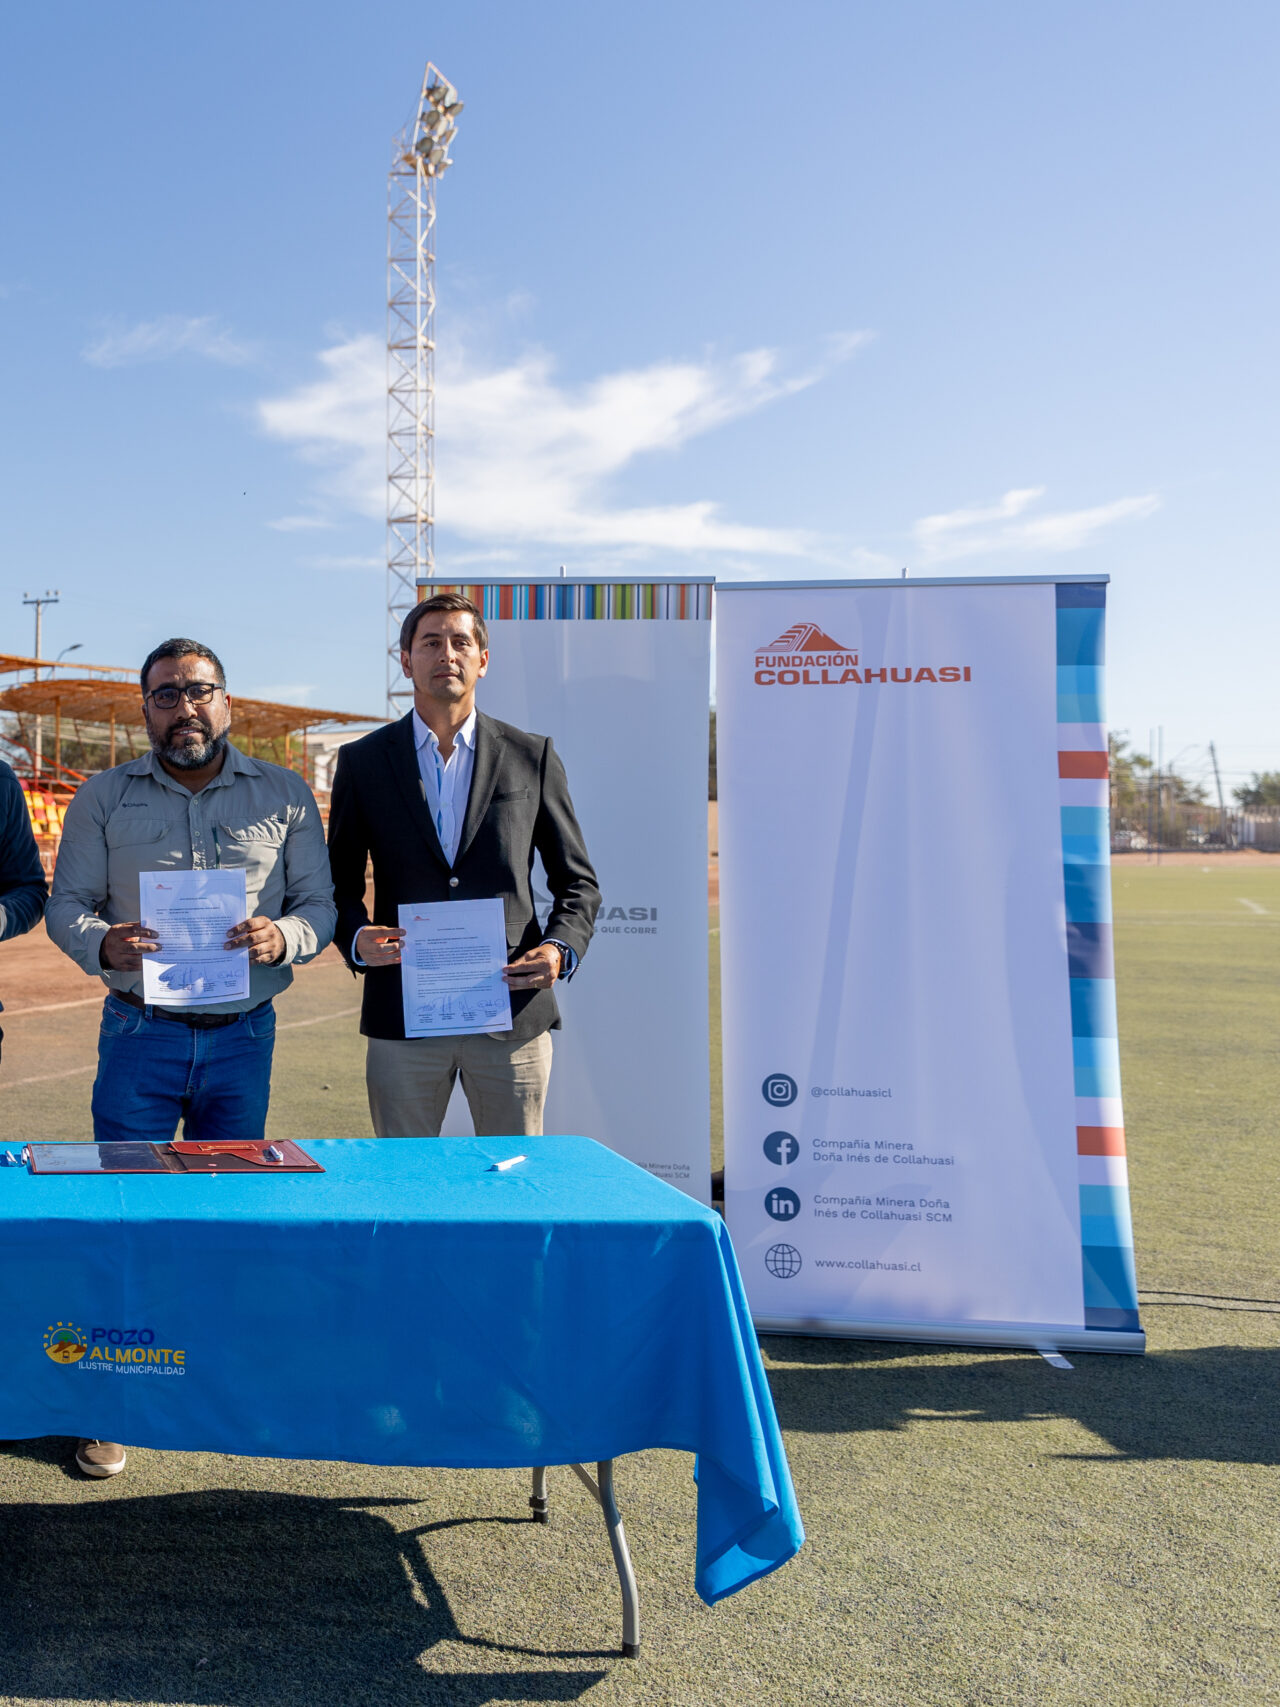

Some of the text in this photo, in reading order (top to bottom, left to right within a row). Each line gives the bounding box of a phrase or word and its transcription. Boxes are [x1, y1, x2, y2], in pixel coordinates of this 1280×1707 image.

[755, 653, 858, 667] FUNDACIÓN
[754, 667, 971, 685] COLLAHUASI
[601, 926, 621, 934] QUE
[811, 1086, 892, 1098] @collahuasicl
[813, 1139, 913, 1150] Compañía Minera
[813, 1152, 954, 1165] Doña Inés de Collahuasi
[814, 1195, 950, 1208] Compañía Minera Doña
[814, 1208, 952, 1222] Inés de Collahuasi SCM
[815, 1258, 922, 1271] www.collahuasi.cl
[92, 1328, 155, 1345] POZO
[90, 1346, 185, 1365] ALMONTE
[78, 1361, 186, 1375] ILUSTRE MUNICIPALIDAD
